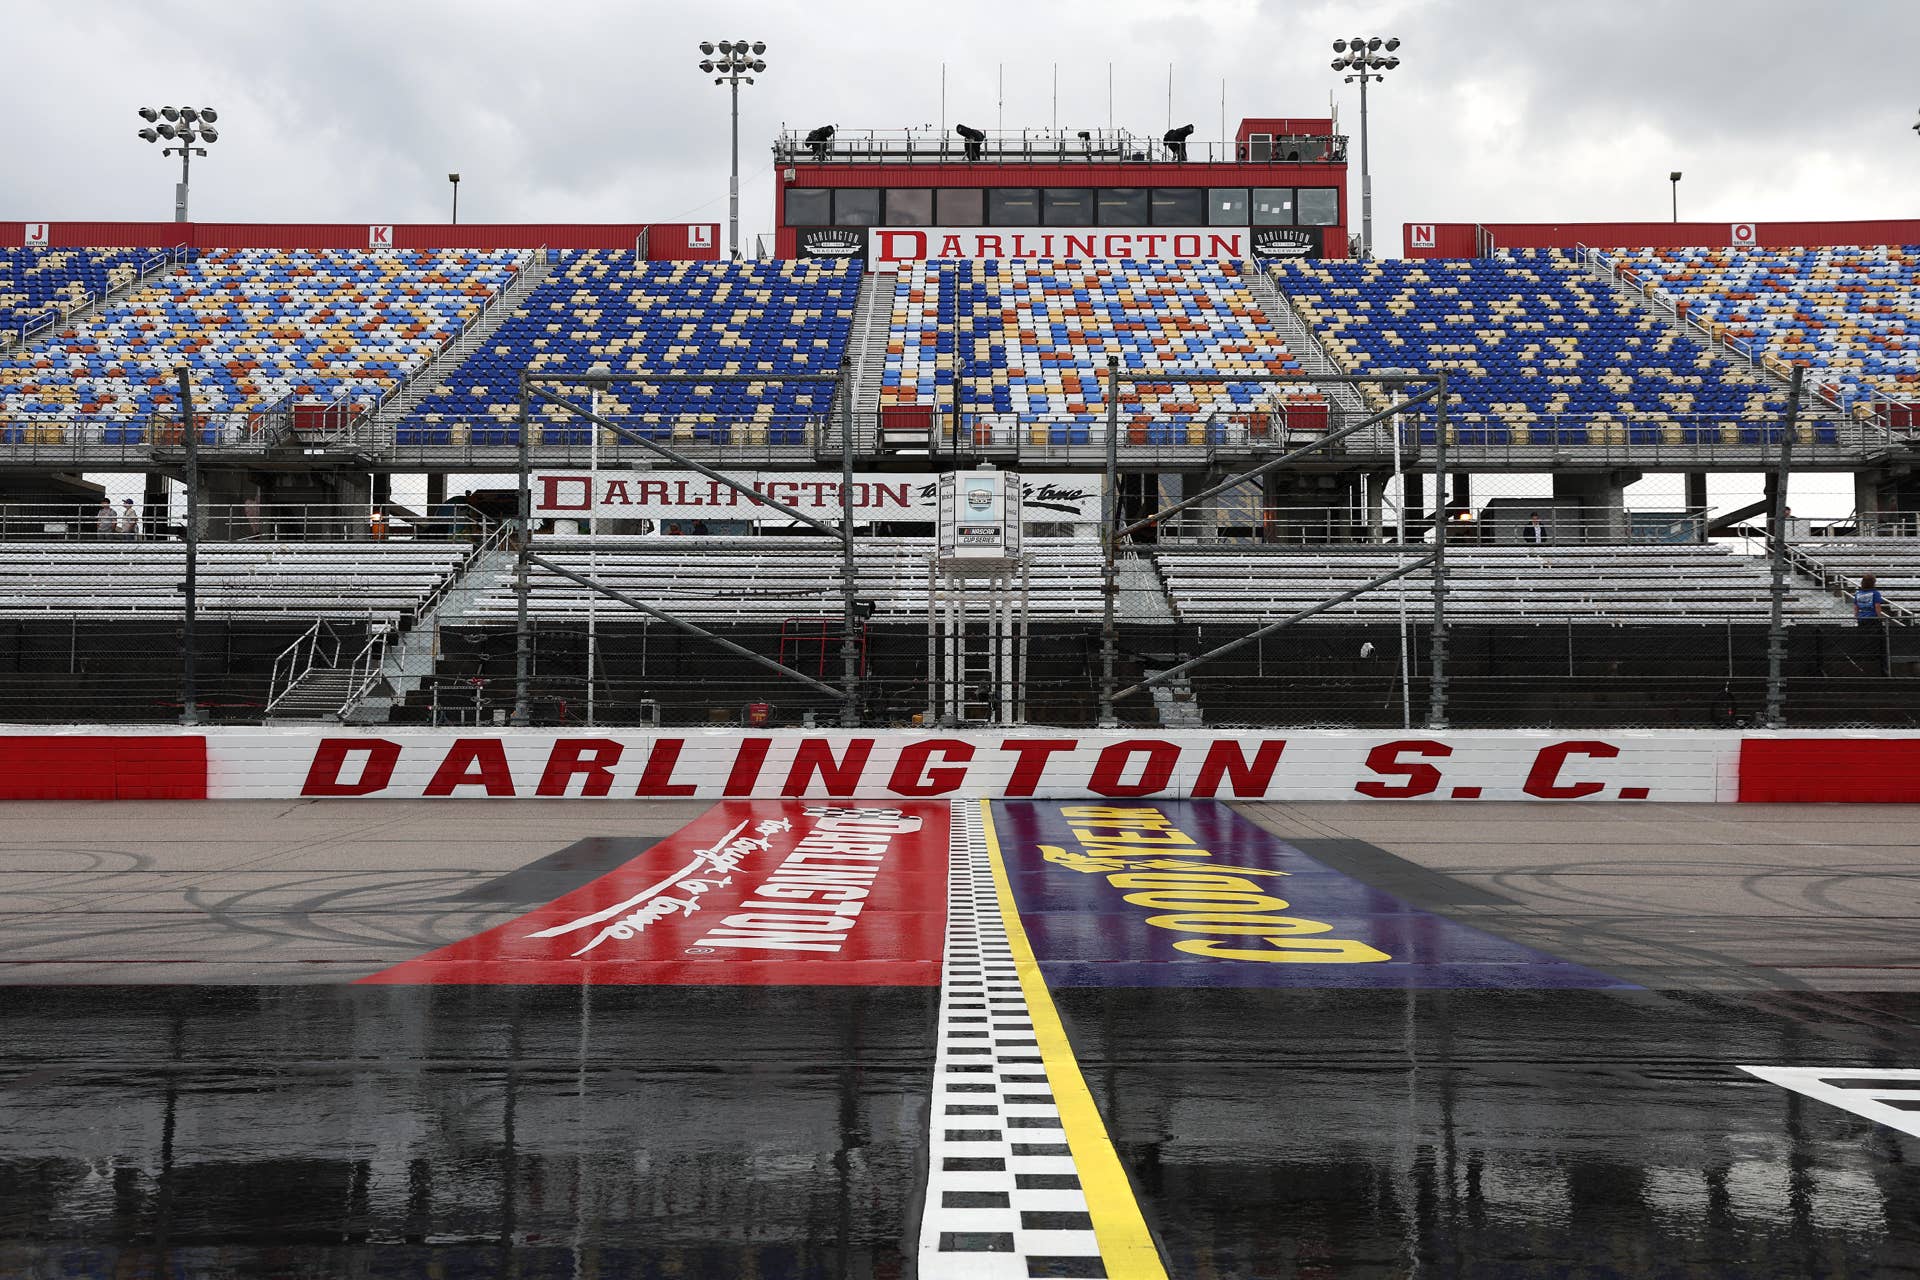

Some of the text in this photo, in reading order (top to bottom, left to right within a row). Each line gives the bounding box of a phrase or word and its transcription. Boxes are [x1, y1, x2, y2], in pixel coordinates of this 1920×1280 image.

[31, 224, 43, 240] J
[373, 226, 388, 243] K
[695, 226, 705, 242] L
[806, 230, 860, 244] DARLINGTON
[1257, 230, 1310, 244] DARLINGTON
[1416, 226, 1431, 242] N
[1735, 224, 1752, 241] O
[875, 230, 1242, 262] DARLINGTON
[536, 475, 912, 512] DARLINGTON
[300, 738, 1287, 797] DARLINGTON
[693, 815, 923, 952] DARLINGTON
[1059, 806, 1392, 963] GOODYEAR
